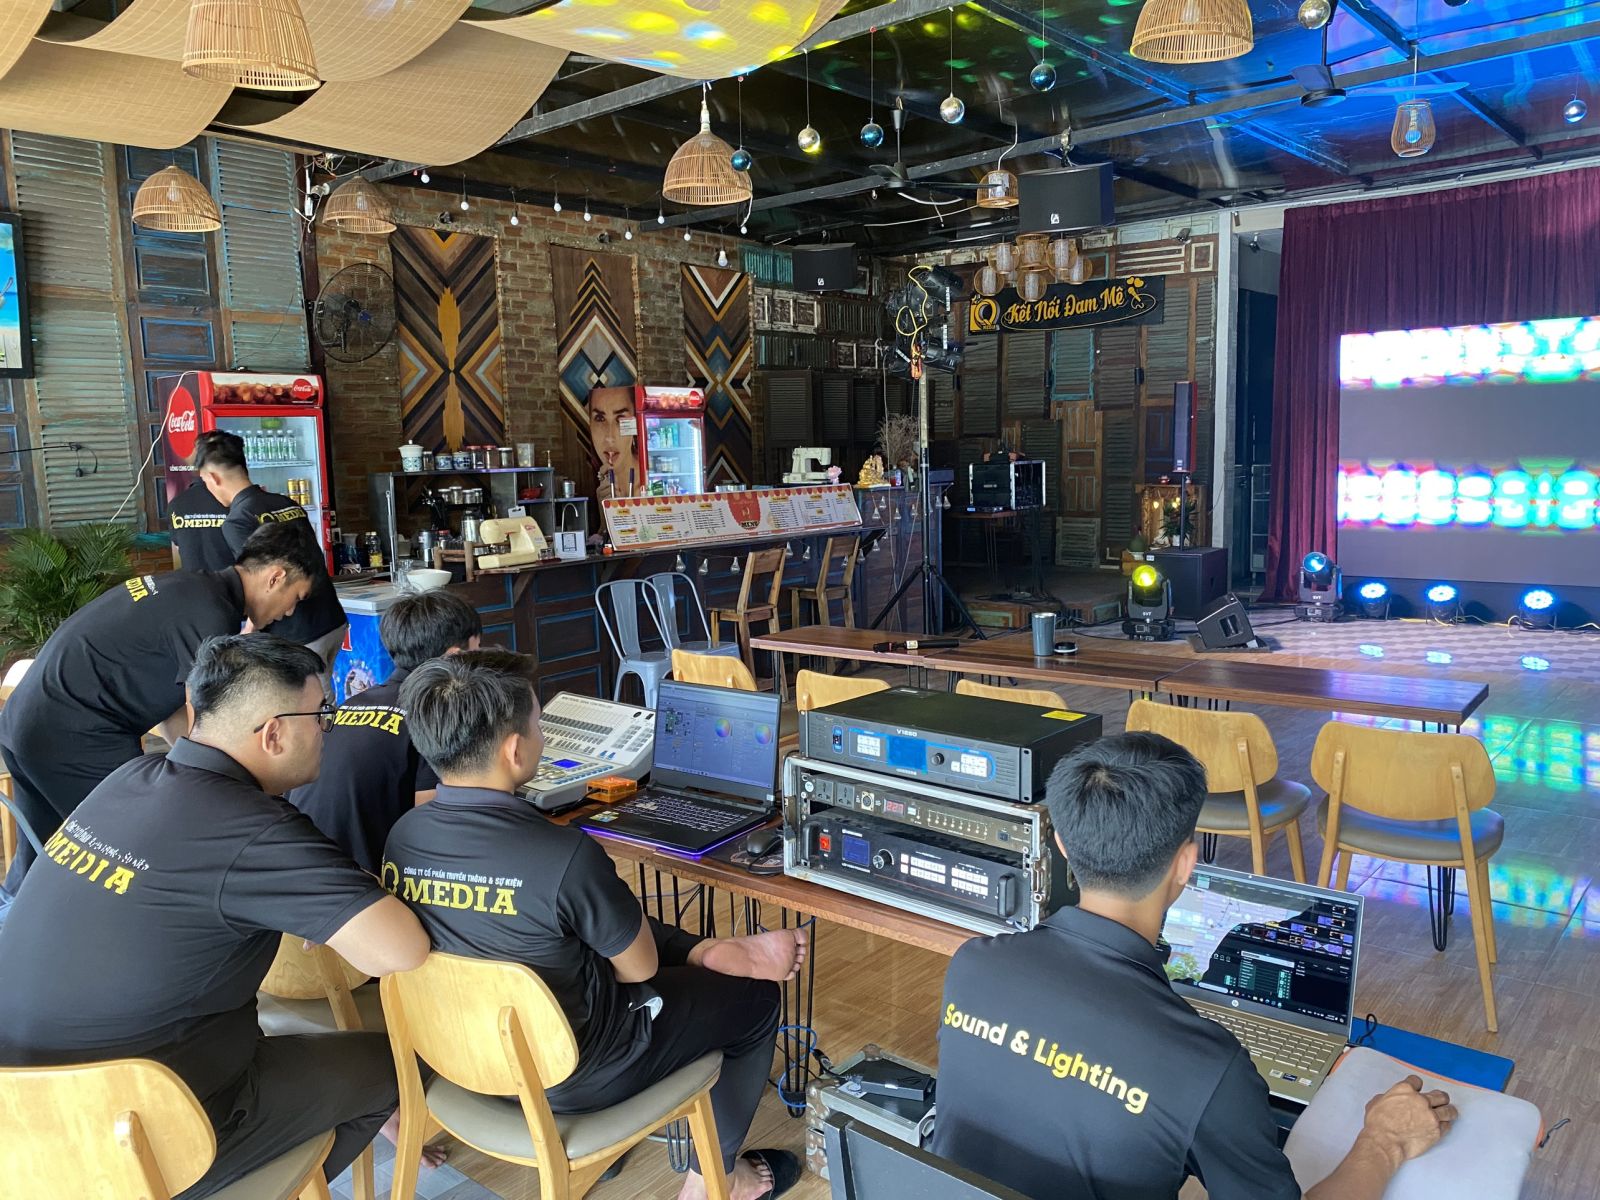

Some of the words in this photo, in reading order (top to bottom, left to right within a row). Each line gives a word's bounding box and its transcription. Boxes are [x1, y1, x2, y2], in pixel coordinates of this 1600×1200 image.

[1006, 300, 1031, 324] Kết
[1034, 296, 1060, 322] Nối
[1063, 294, 1098, 318] Đam
[1100, 286, 1124, 311] Mê
[44, 832, 135, 895] MEDIA
[488, 877, 494, 885] &
[403, 878, 517, 915] MEDIA
[944, 1003, 1008, 1046] Sound
[1010, 1029, 1031, 1056] &
[1033, 1038, 1149, 1115] Lighting
